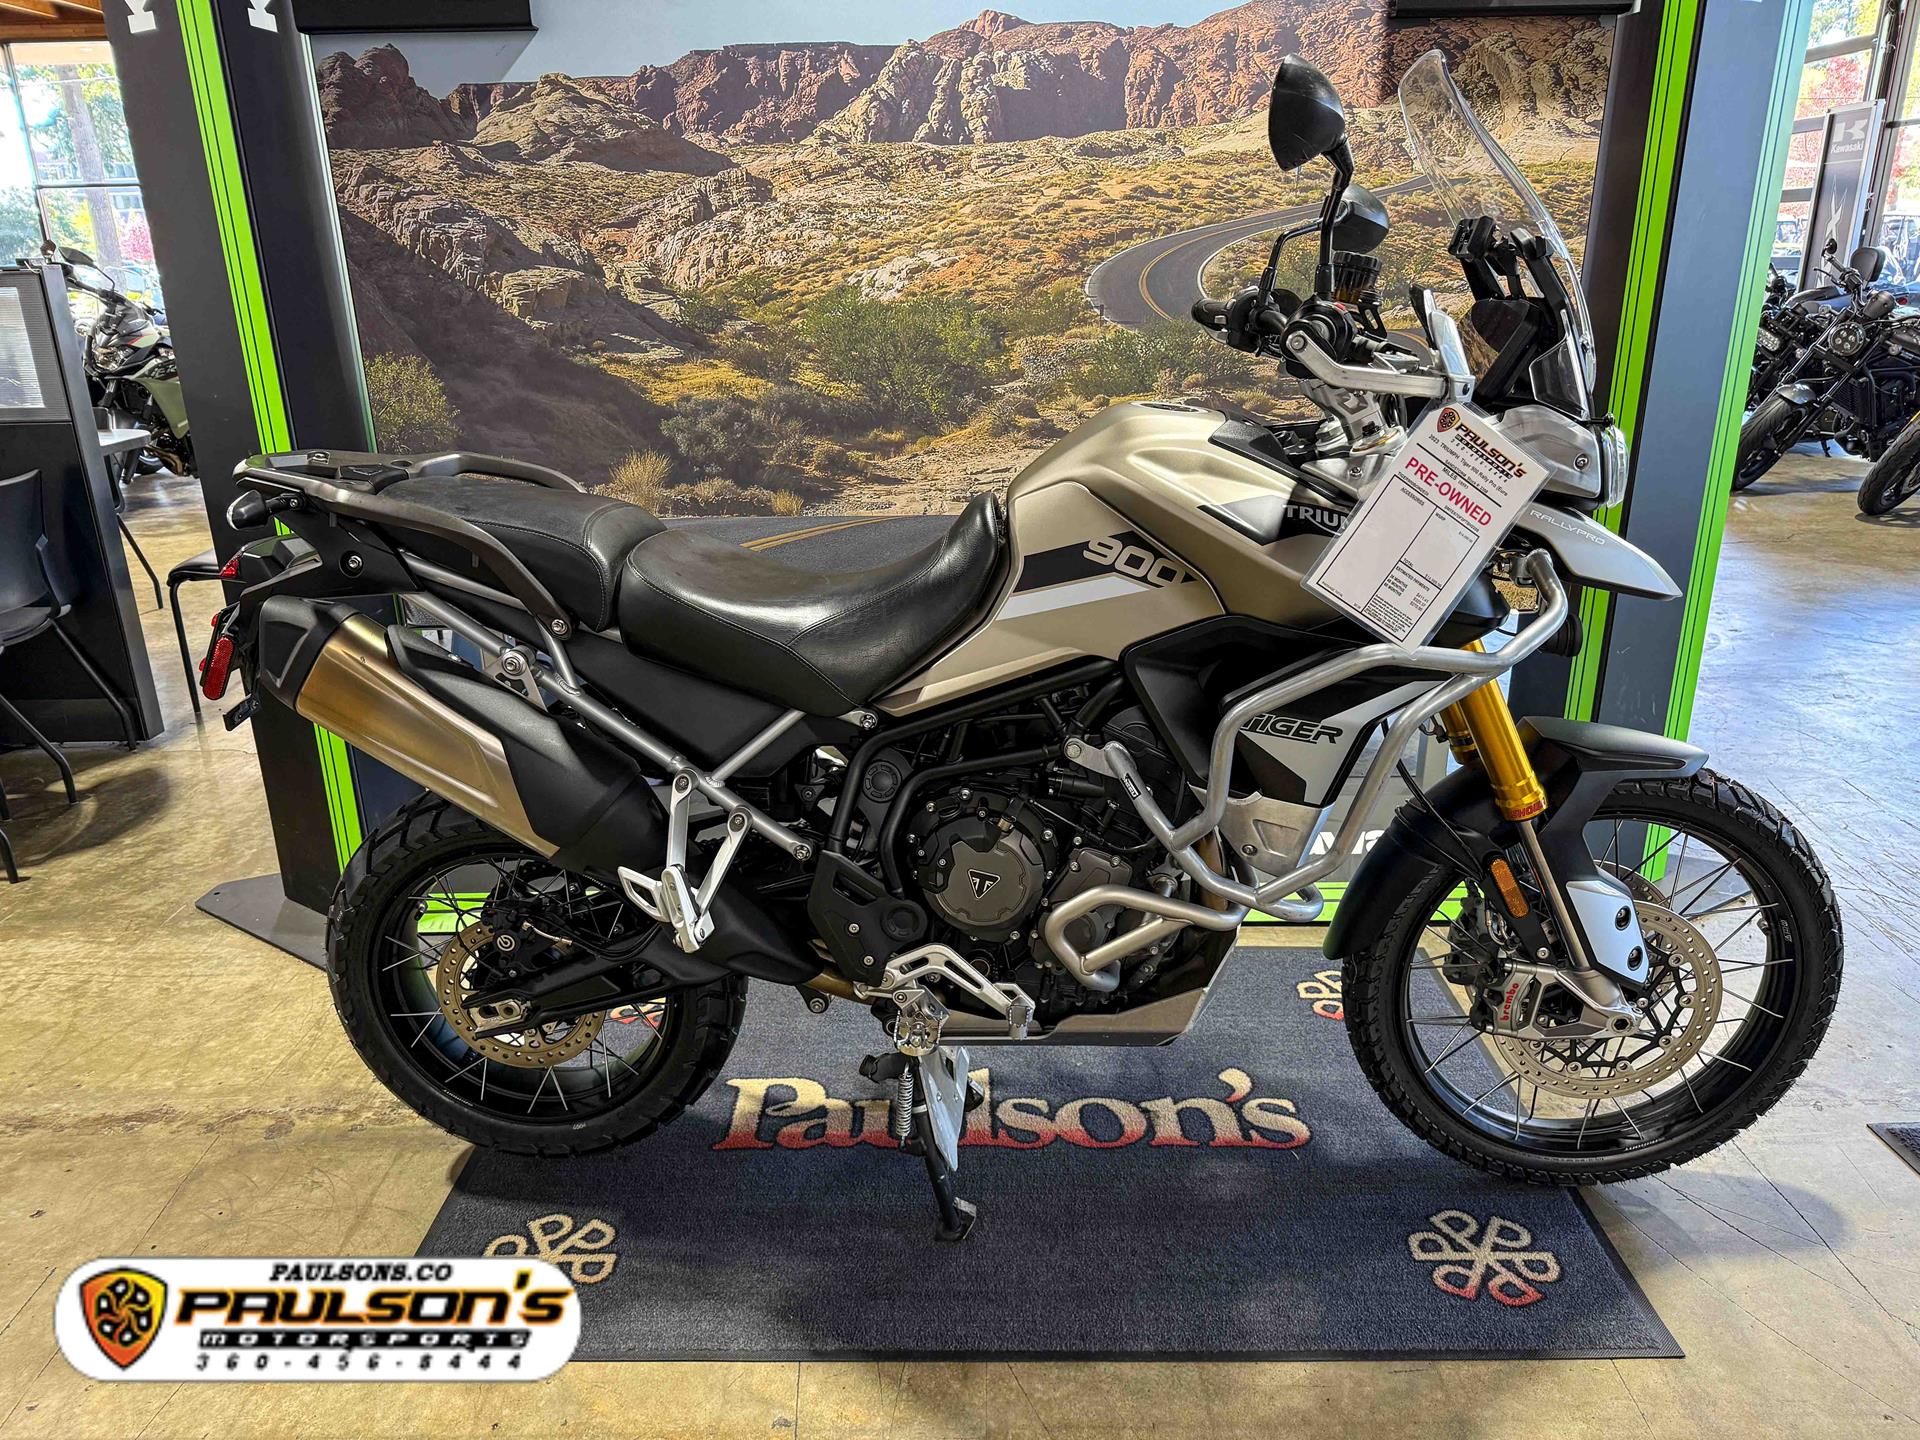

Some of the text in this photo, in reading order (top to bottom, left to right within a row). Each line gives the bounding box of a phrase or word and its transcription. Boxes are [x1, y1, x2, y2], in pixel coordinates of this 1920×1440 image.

[1831, 140, 1864, 154] Kawasaki
[1439, 442, 1460, 459] TRIUMPH
[1459, 457, 1472, 469] Tiger
[1477, 471, 1489, 482] Rally
[1488, 479, 1497, 488] Pro
[1441, 466, 1457, 480] MILES
[1454, 422, 1527, 478] PAULSON'S
[1404, 456, 1493, 527] PRE-OWNED
[1083, 538, 1187, 586] 900
[1242, 714, 1343, 744] TIGER
[1499, 982, 1520, 1021] brembo
[711, 1068, 1313, 1151] Paulson's
